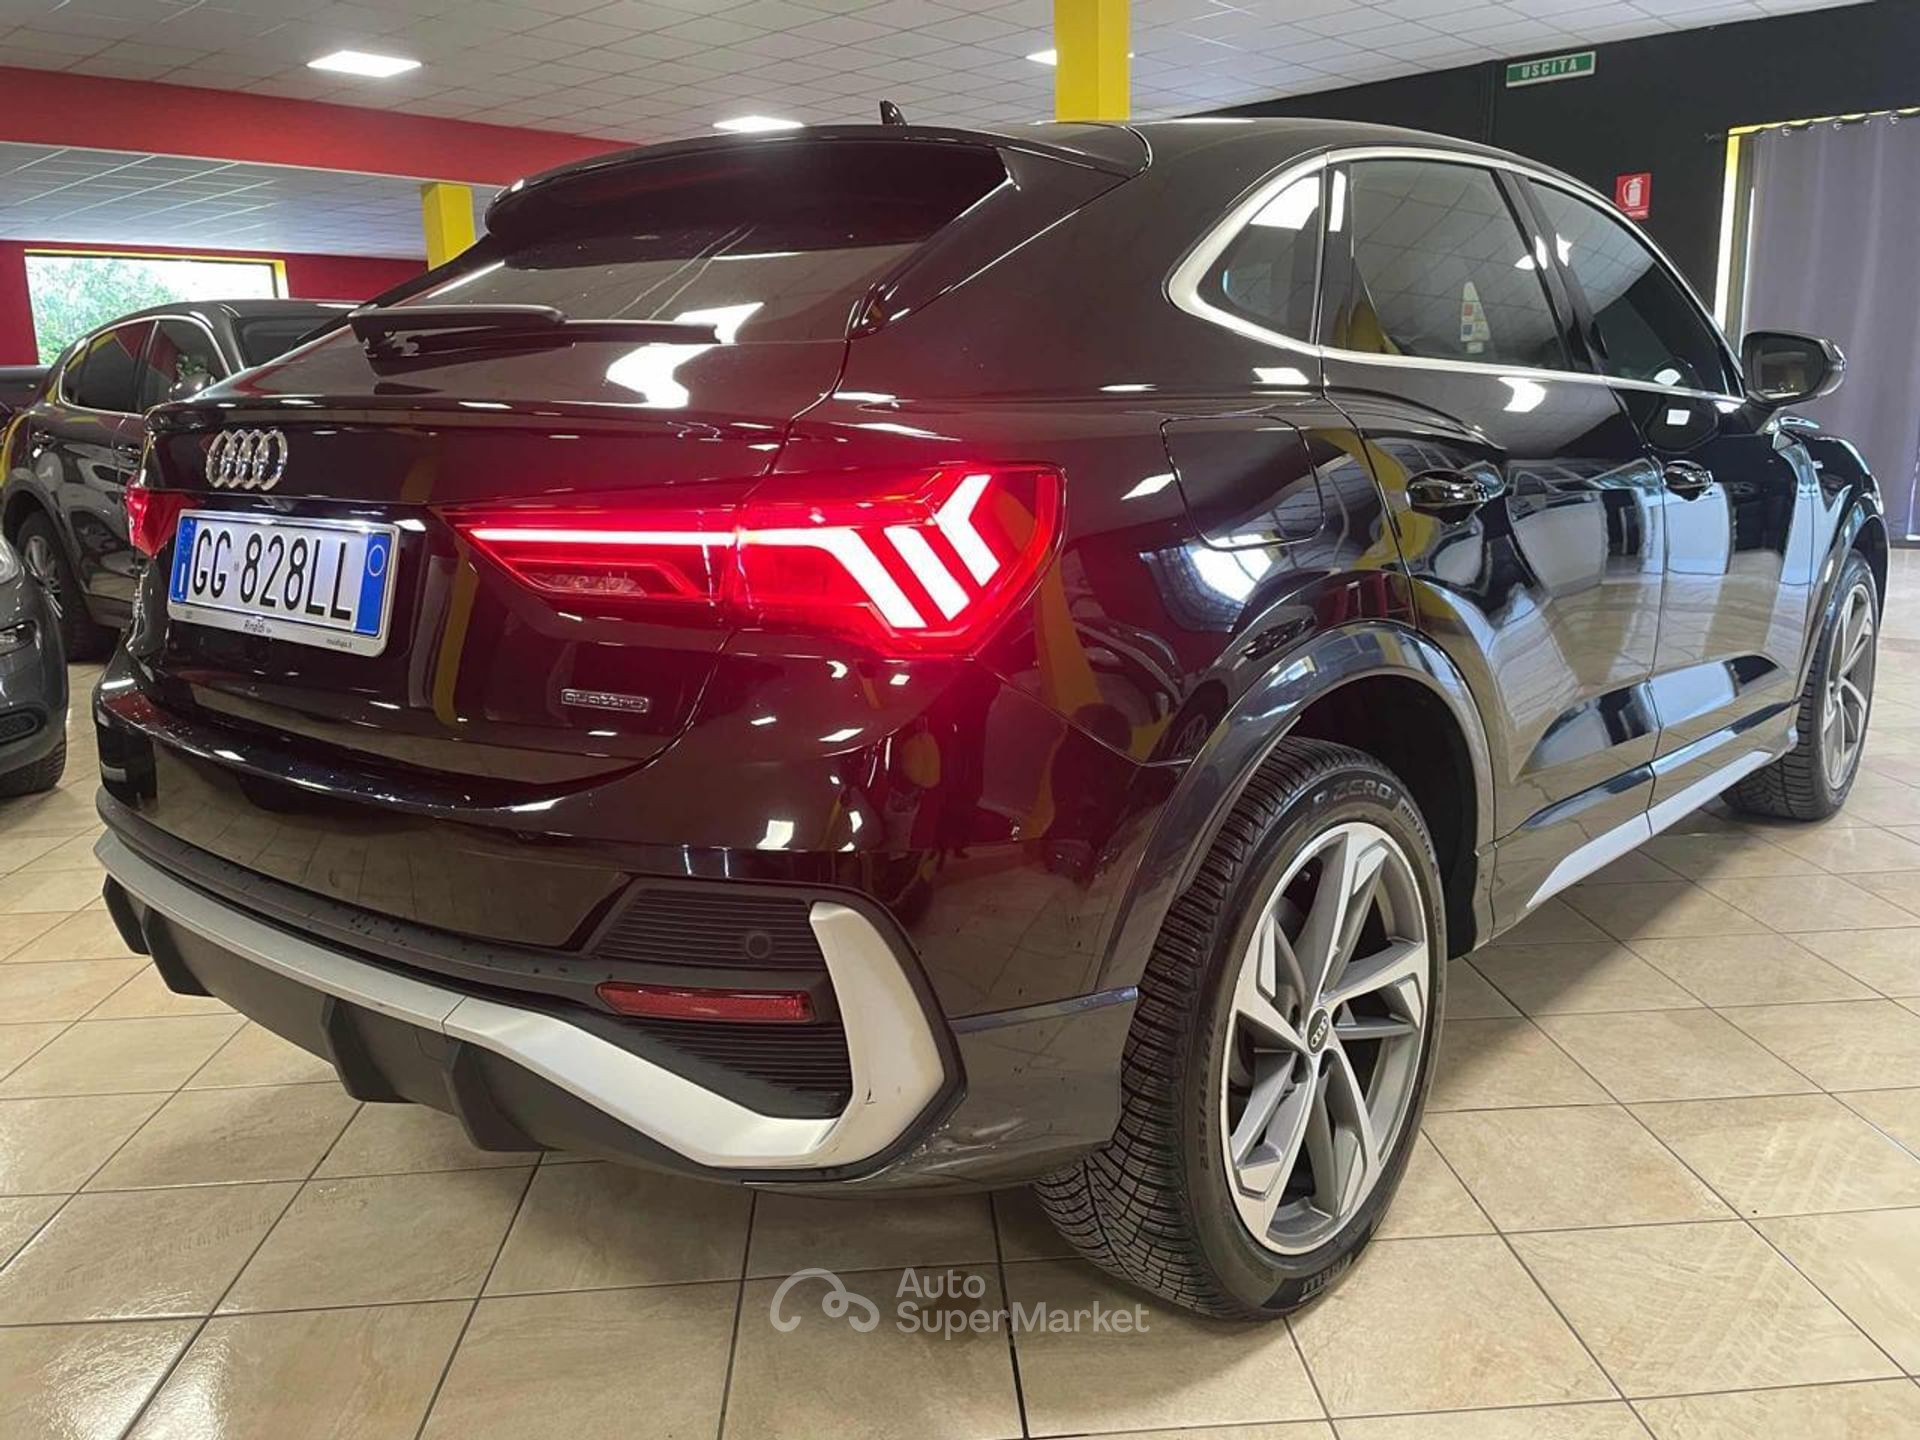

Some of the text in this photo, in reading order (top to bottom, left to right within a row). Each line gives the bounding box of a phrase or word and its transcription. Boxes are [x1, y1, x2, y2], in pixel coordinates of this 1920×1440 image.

[1522, 59, 1577, 78] USCITA
[192, 528, 352, 620] GG 828LL
[564, 692, 644, 709] quattro
[1333, 778, 1396, 801] ZERO
